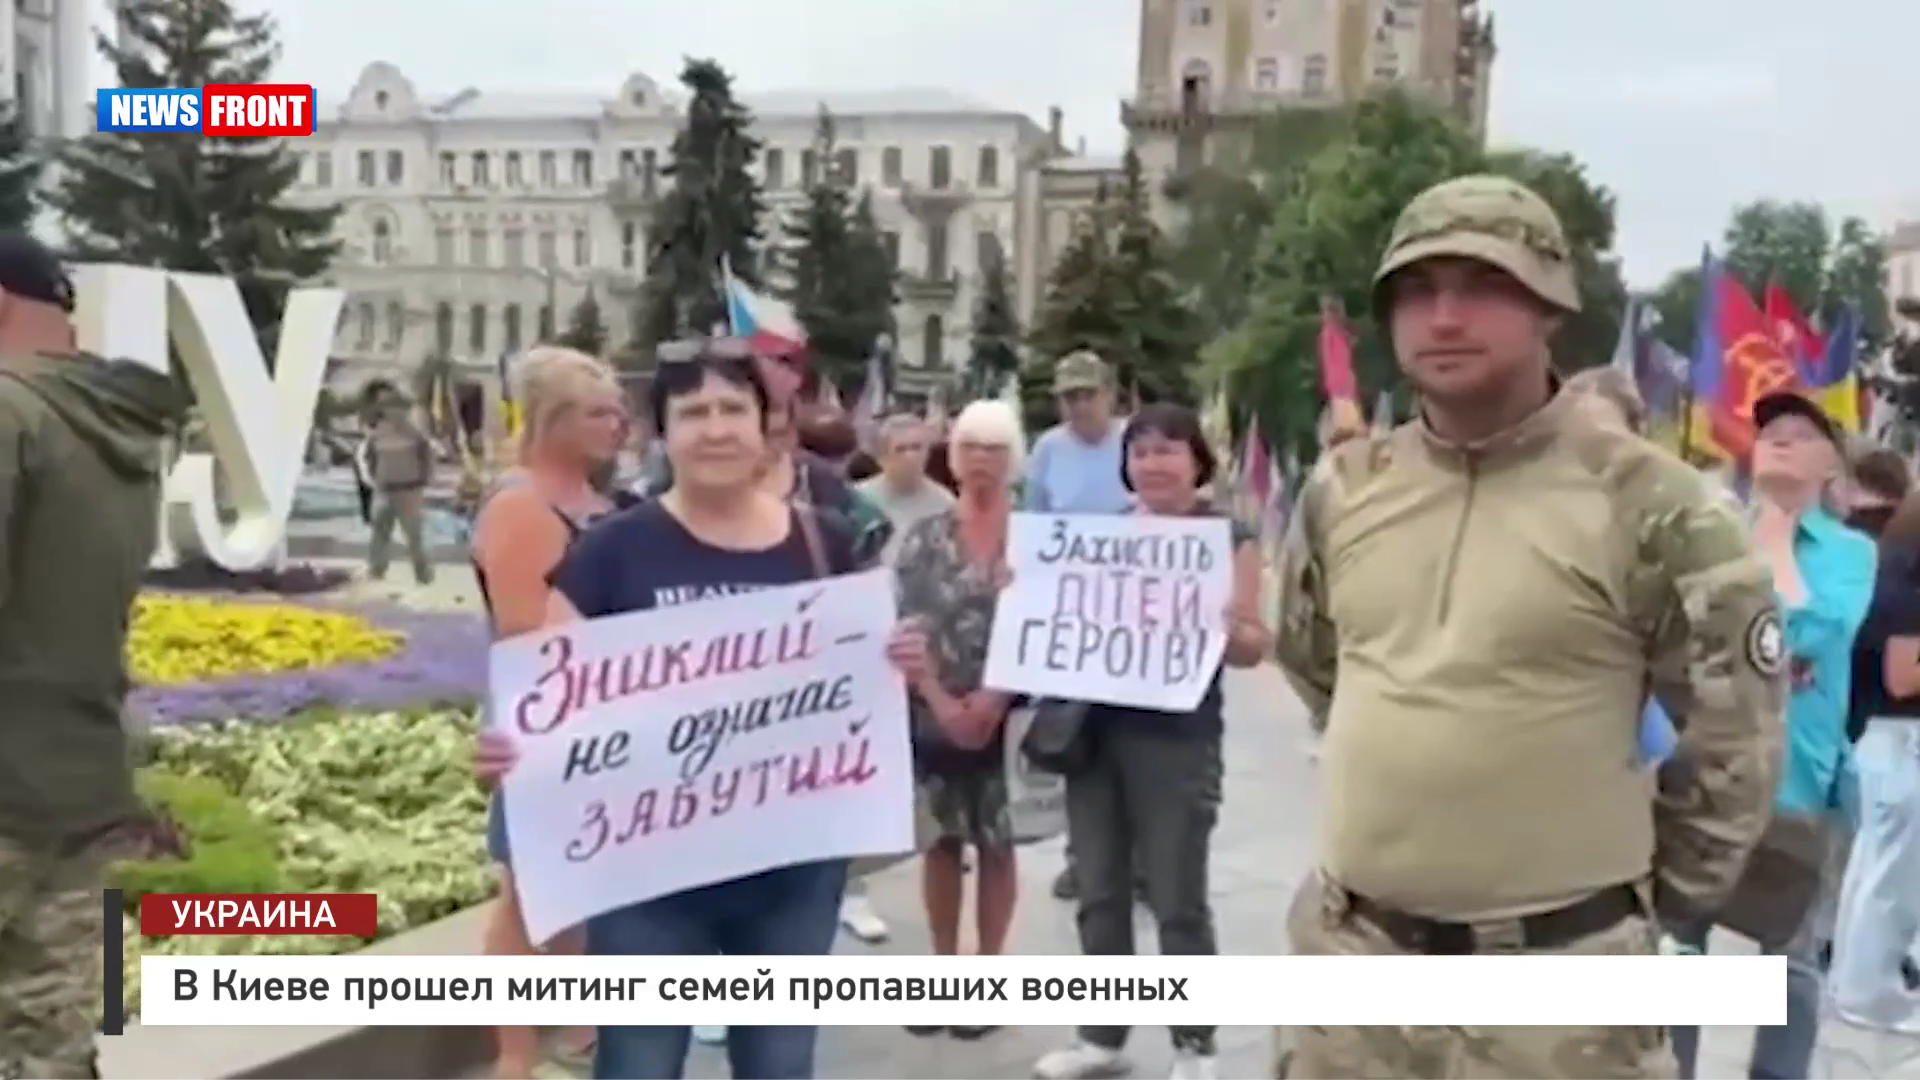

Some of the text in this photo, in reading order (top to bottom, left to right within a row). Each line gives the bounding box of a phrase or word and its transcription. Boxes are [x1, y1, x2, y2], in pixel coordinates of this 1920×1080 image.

[562, 674, 854, 784] не означає
[564, 715, 878, 864] ЗАБУТИЙ
